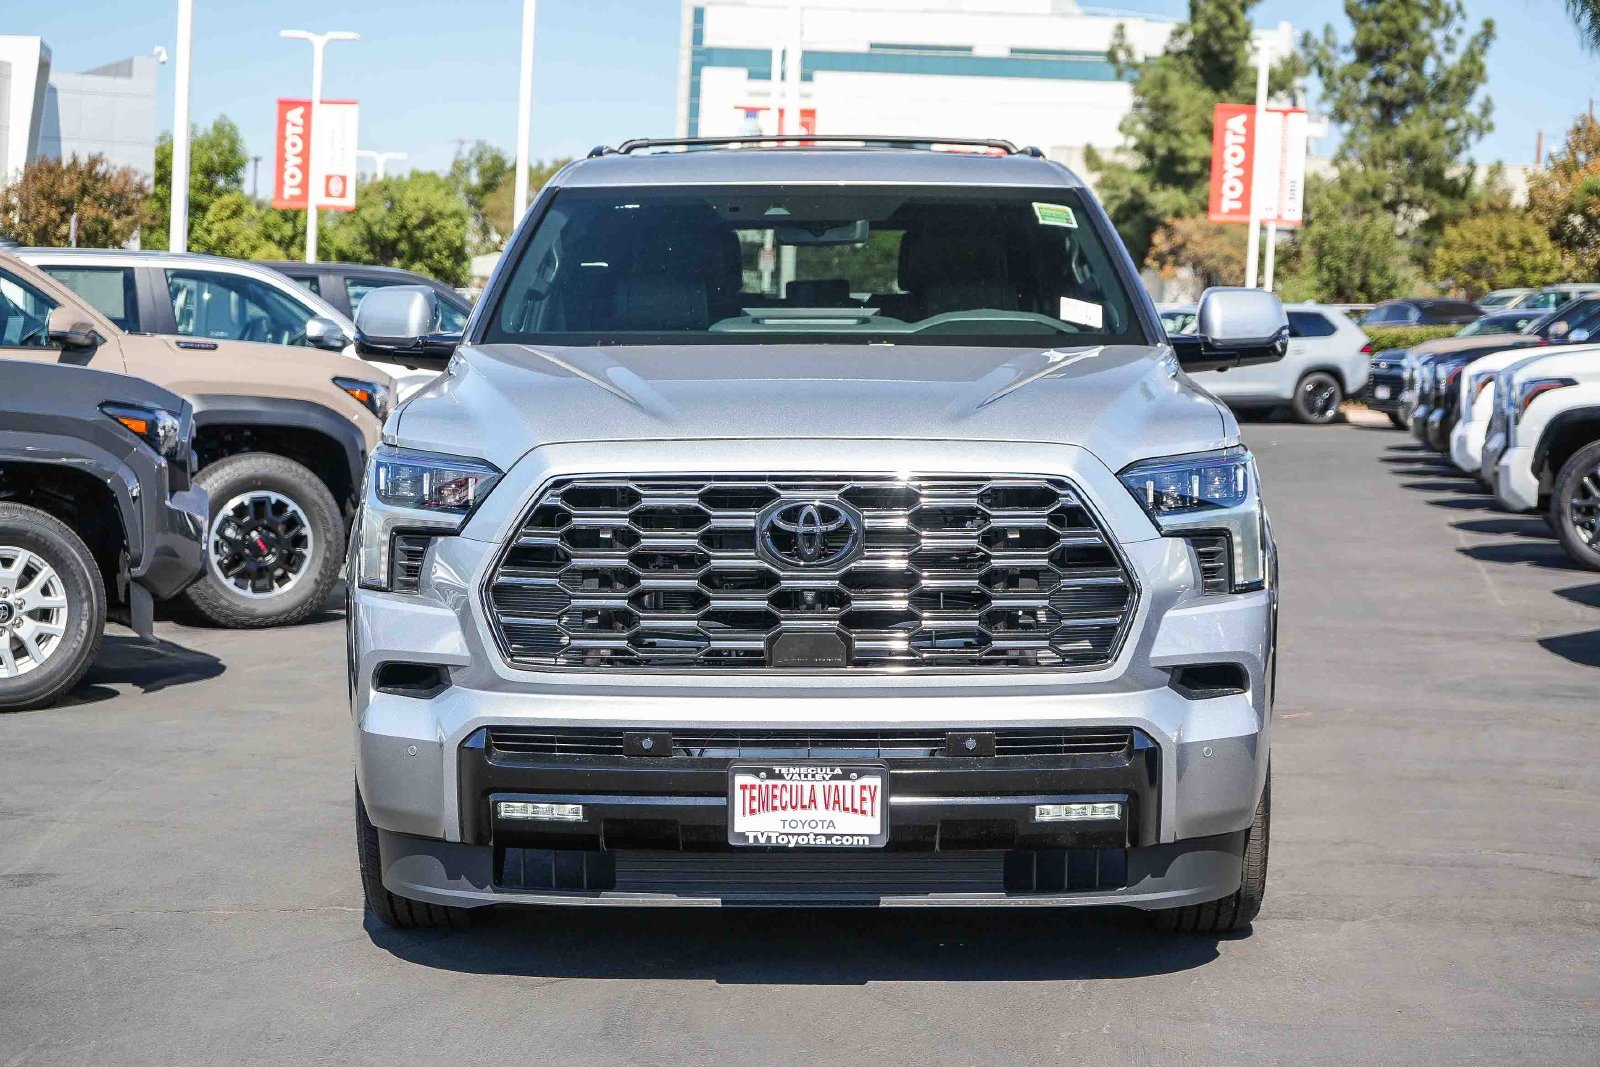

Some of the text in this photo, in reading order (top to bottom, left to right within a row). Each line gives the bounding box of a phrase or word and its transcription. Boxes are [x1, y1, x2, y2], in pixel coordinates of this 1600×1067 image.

[284, 106, 304, 199] TOYOTA
[1221, 114, 1247, 213] TOYOTA
[773, 766, 842, 774] TEMECULA
[739, 784, 877, 817] TEMECULA VALLEY
[780, 819, 836, 830] TOYOTA
[745, 831, 870, 847] TVToyota.com
